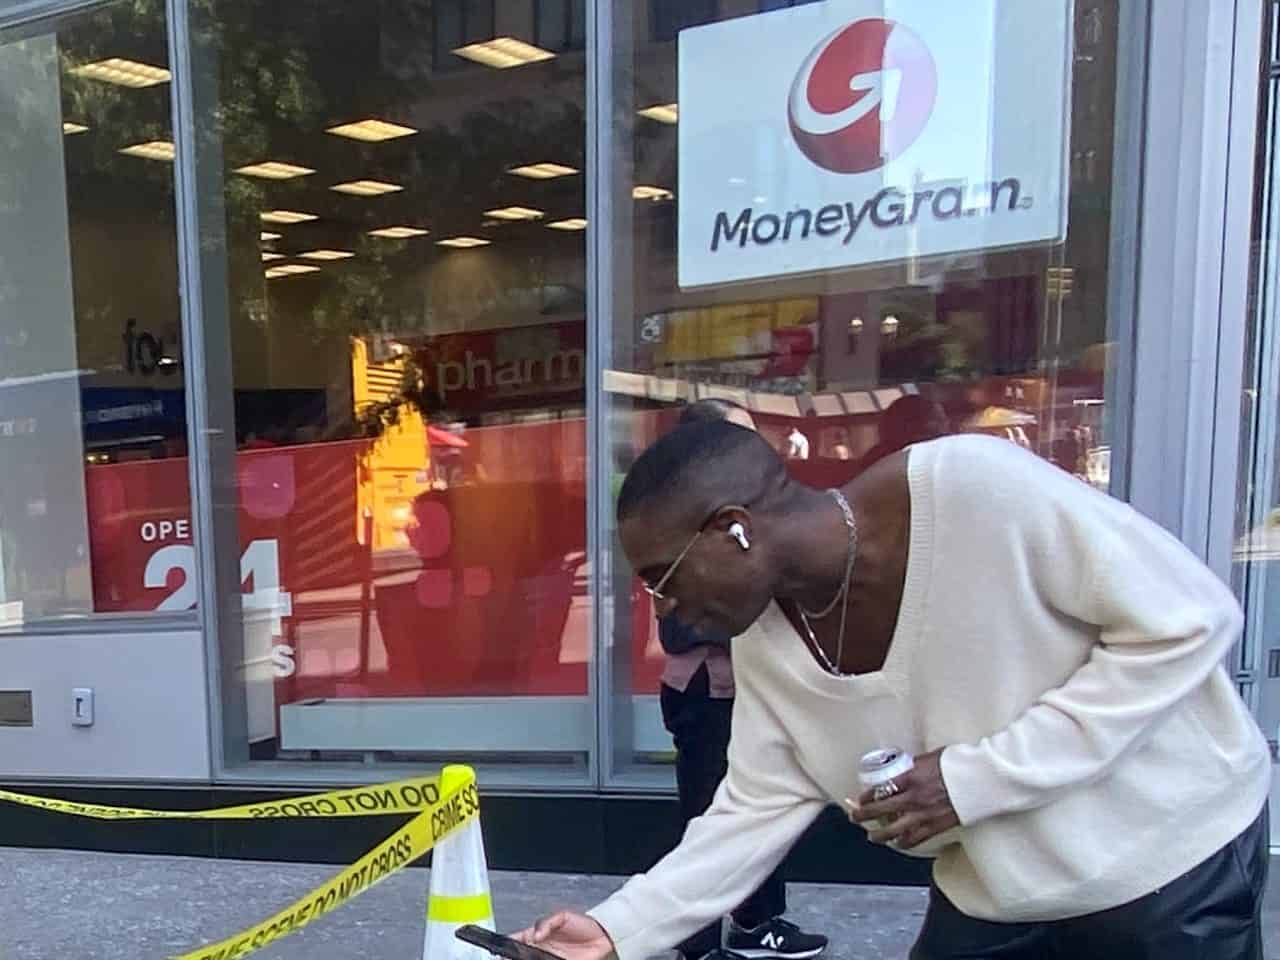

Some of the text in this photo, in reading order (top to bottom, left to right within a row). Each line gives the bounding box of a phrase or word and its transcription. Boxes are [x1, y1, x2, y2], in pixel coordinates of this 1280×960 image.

[710, 177, 1021, 251] MoneyGram
[437, 349, 585, 403] pharm
[140, 520, 189, 541] OPE
[337, 864, 370, 901] NOT
[369, 833, 412, 882] CROSS
